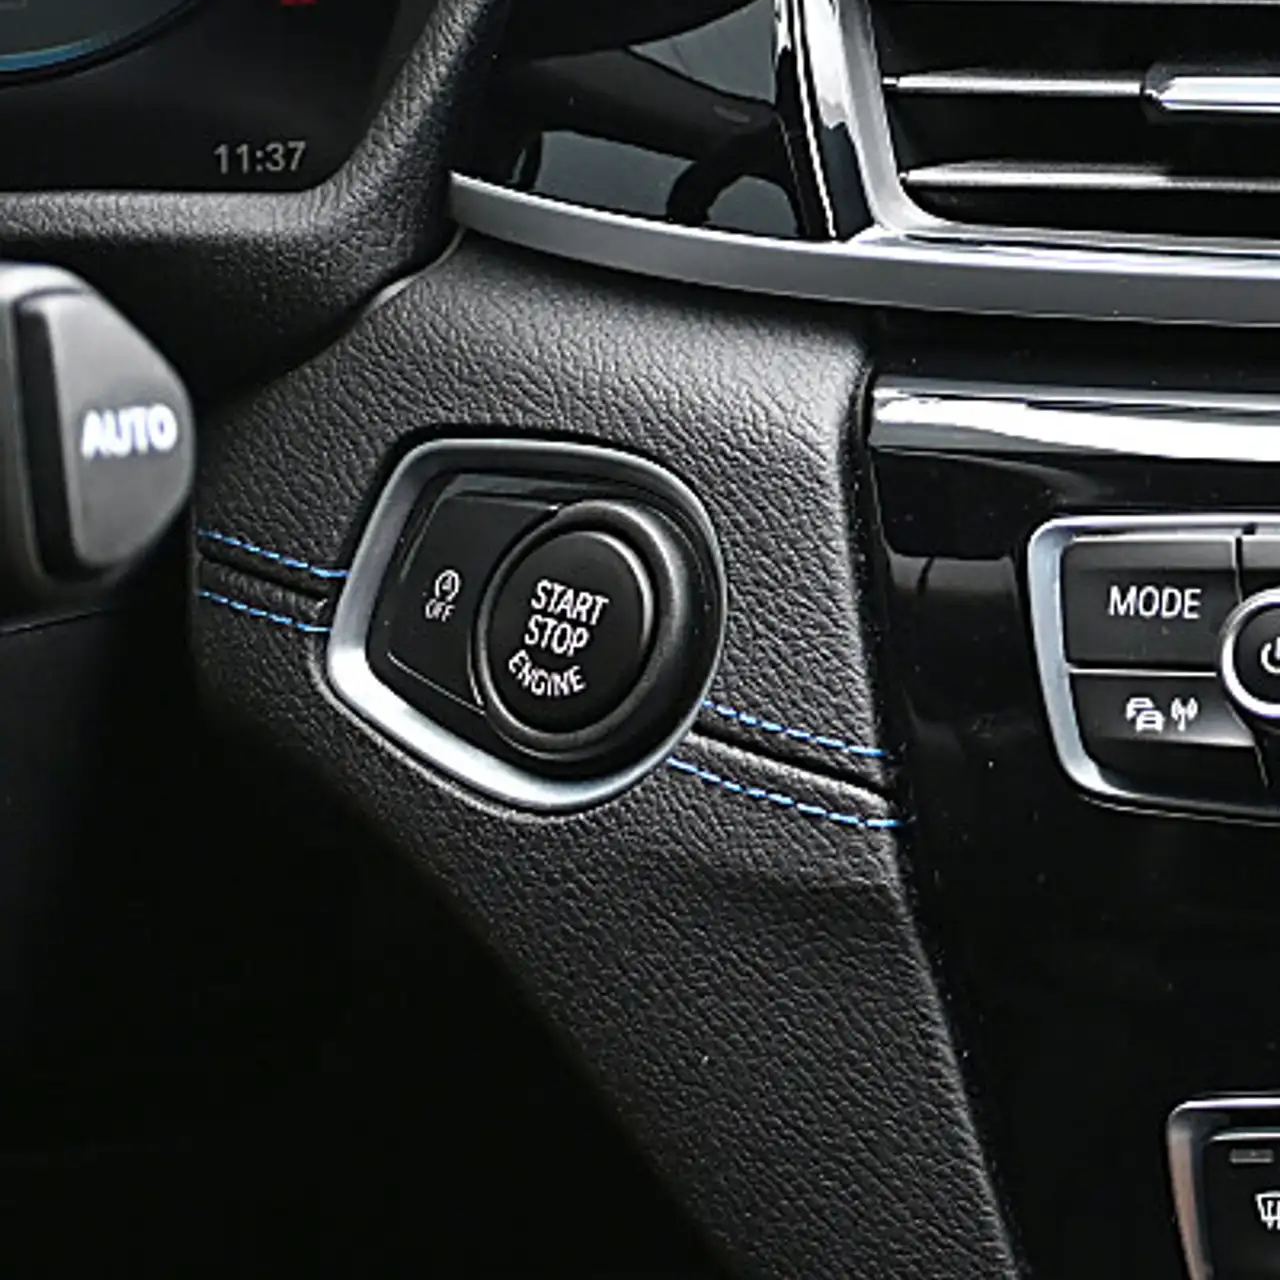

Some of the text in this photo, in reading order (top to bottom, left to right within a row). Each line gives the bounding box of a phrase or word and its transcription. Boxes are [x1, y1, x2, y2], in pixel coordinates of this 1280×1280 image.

[215, 141, 305, 173] 11:37
[82, 405, 176, 455] AUTO
[425, 599, 456, 622] OFF
[529, 579, 610, 626] START
[1109, 586, 1201, 618] MODE
[524, 613, 590, 658] STOP
[508, 648, 587, 697] ENGINE
